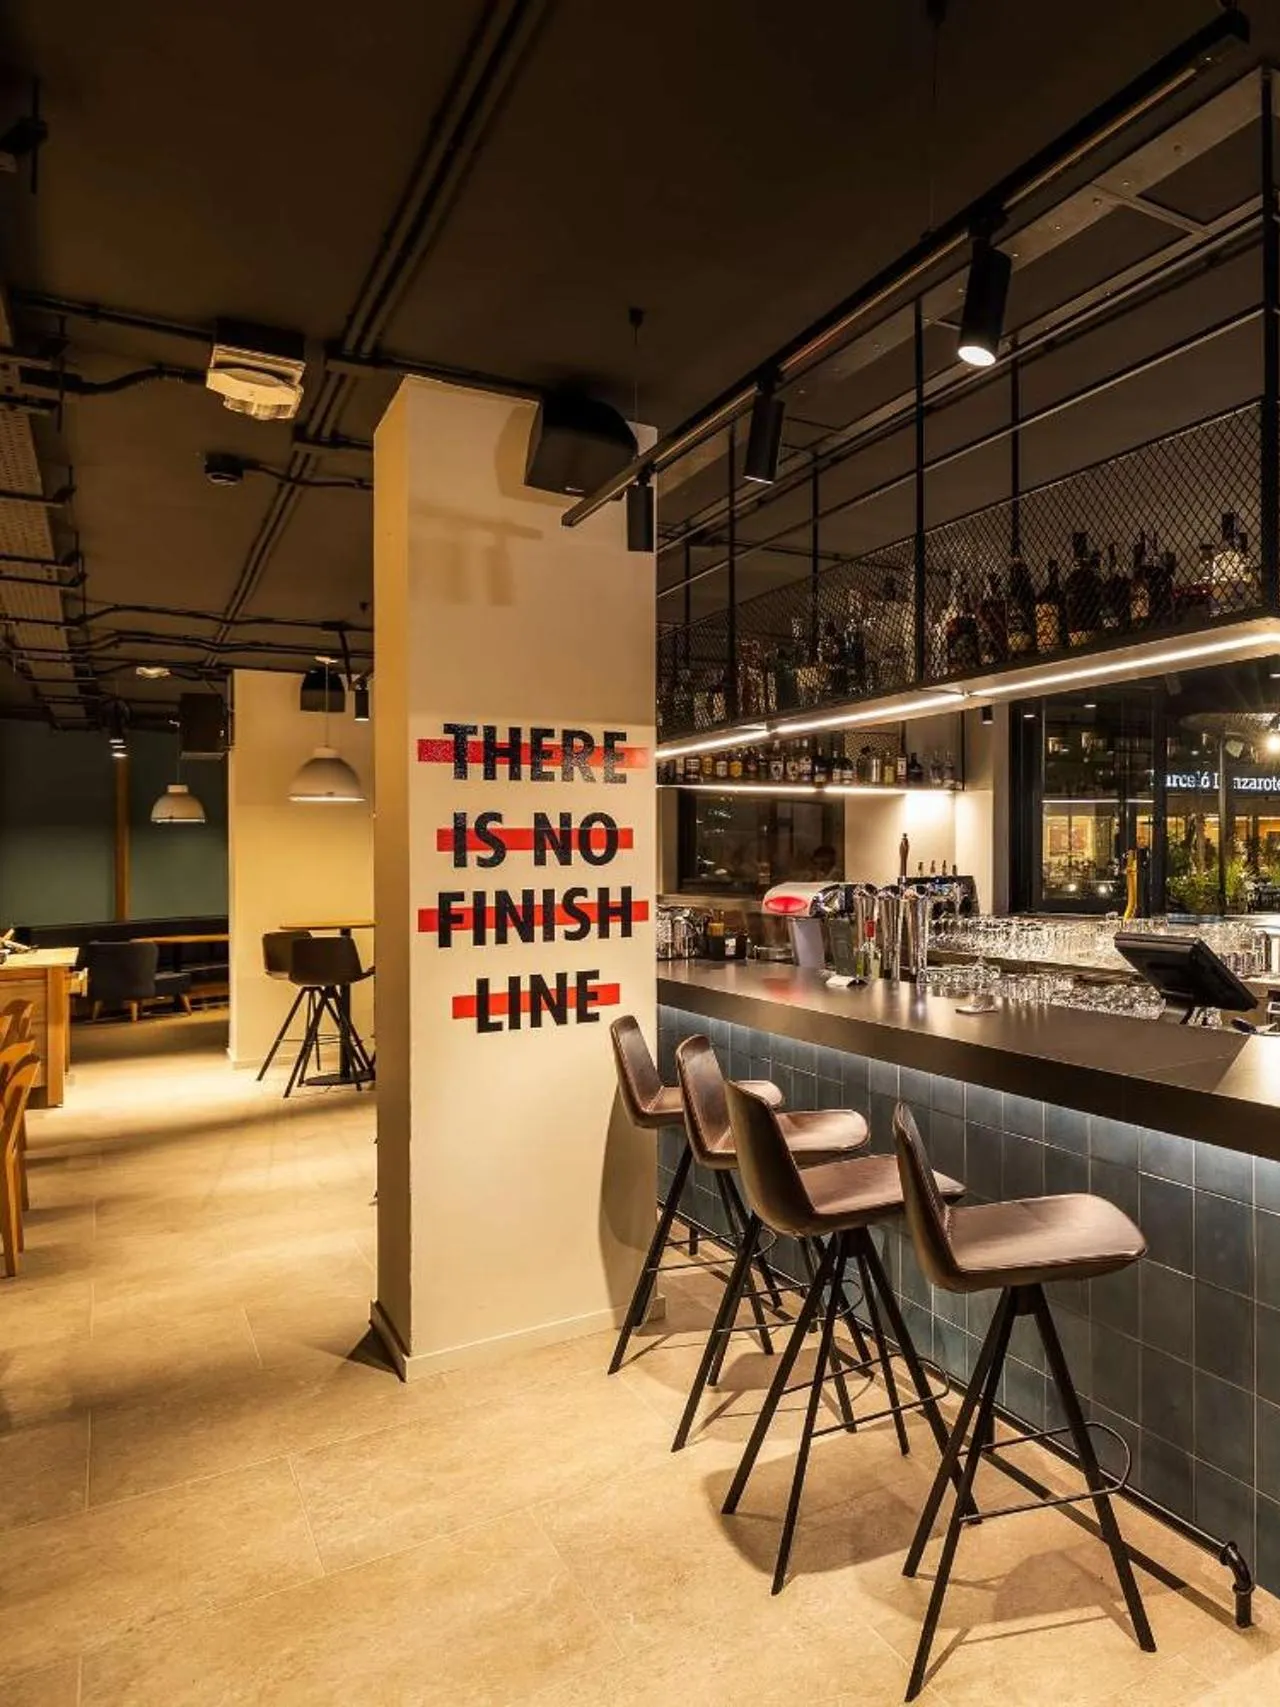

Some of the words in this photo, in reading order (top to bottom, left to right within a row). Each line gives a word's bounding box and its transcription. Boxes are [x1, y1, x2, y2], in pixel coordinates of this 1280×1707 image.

[443, 723, 627, 784] THERE
[453, 811, 507, 868] IS
[533, 811, 619, 867] NO
[438, 886, 632, 948] FINISH
[476, 969, 600, 1034] LINE
